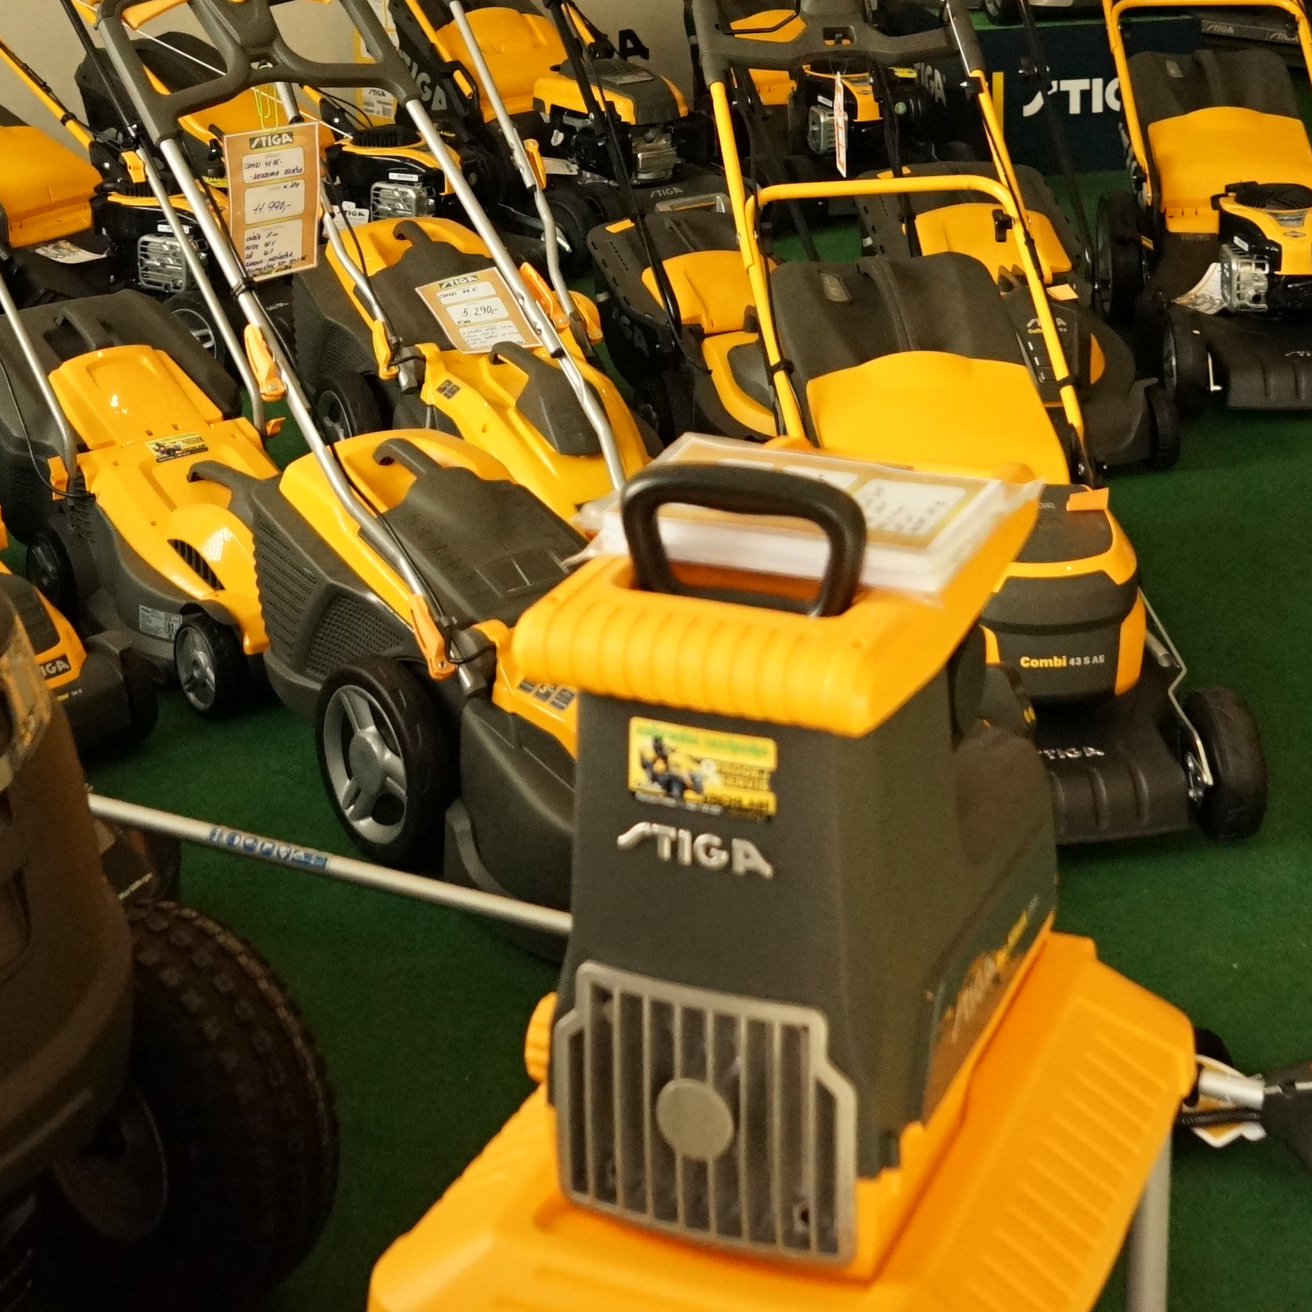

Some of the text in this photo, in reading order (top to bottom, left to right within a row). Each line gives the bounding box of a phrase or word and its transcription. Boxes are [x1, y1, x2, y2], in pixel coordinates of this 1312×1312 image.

[251, 133, 293, 149] STIGA
[649, 187, 683, 198] STIGA
[440, 275, 478, 288] STIGA
[39, 659, 71, 677] IGA
[1020, 654, 1105, 668] Combi 43 S AE
[1038, 746, 1106, 761] TIGA
[616, 820, 774, 880] STIGA
